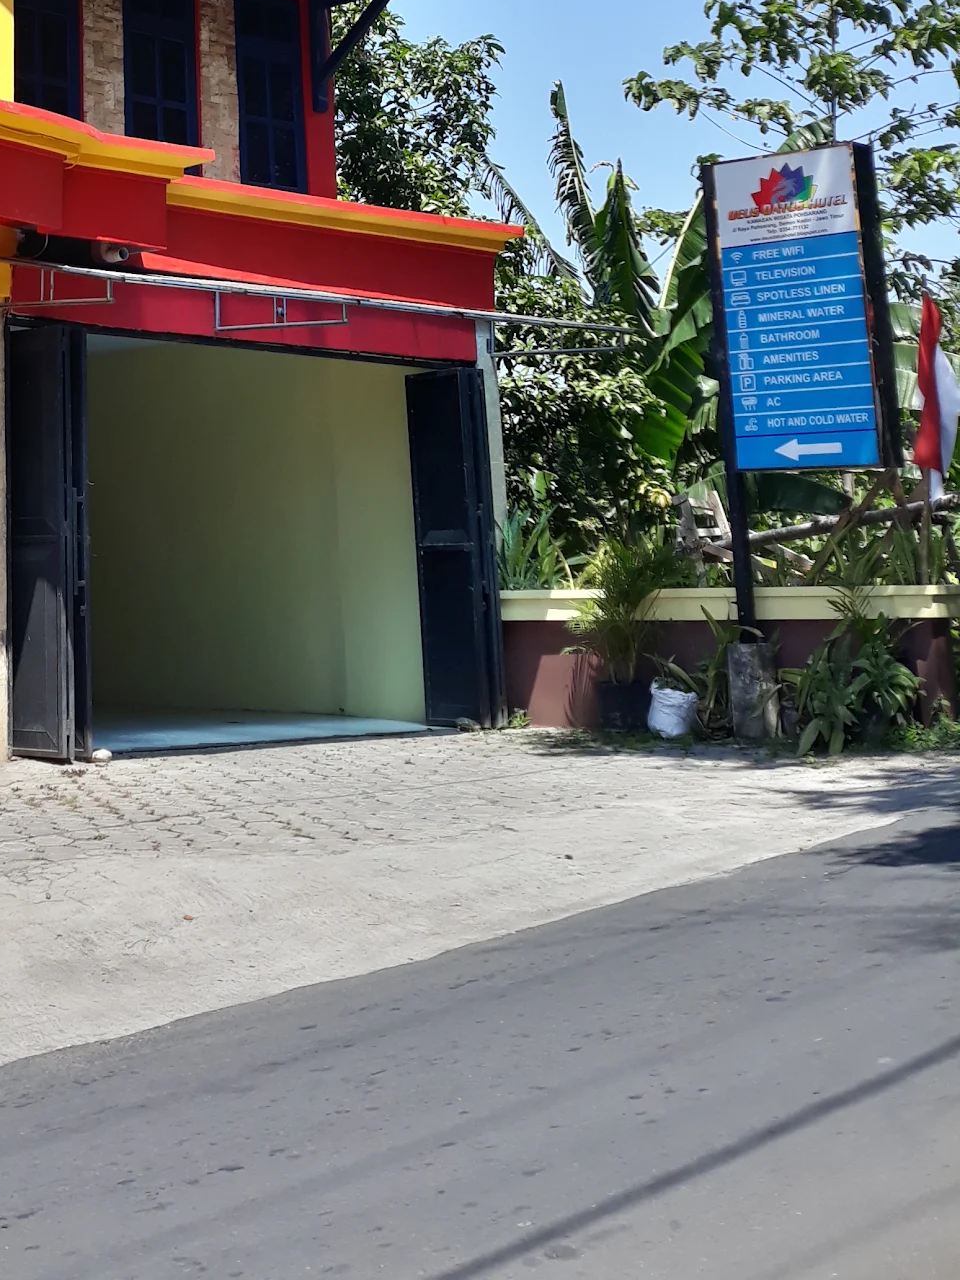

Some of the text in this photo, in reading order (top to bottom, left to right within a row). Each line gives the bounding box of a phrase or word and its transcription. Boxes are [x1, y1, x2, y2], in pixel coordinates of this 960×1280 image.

[807, 194, 848, 209] HOTEL
[752, 245, 804, 260] FREE WIFI
[755, 266, 816, 281] TELEVISION
[757, 283, 845, 302] SPOTLESS LINEN
[758, 305, 845, 323] MINERAL WATER
[760, 329, 820, 343] BATHROOM
[763, 351, 819, 365] AMENITIES
[744, 377, 752, 388] P
[764, 371, 844, 386] PARKING AREA
[766, 397, 781, 407] AC
[767, 412, 869, 428] HOT AND COLD WATER
